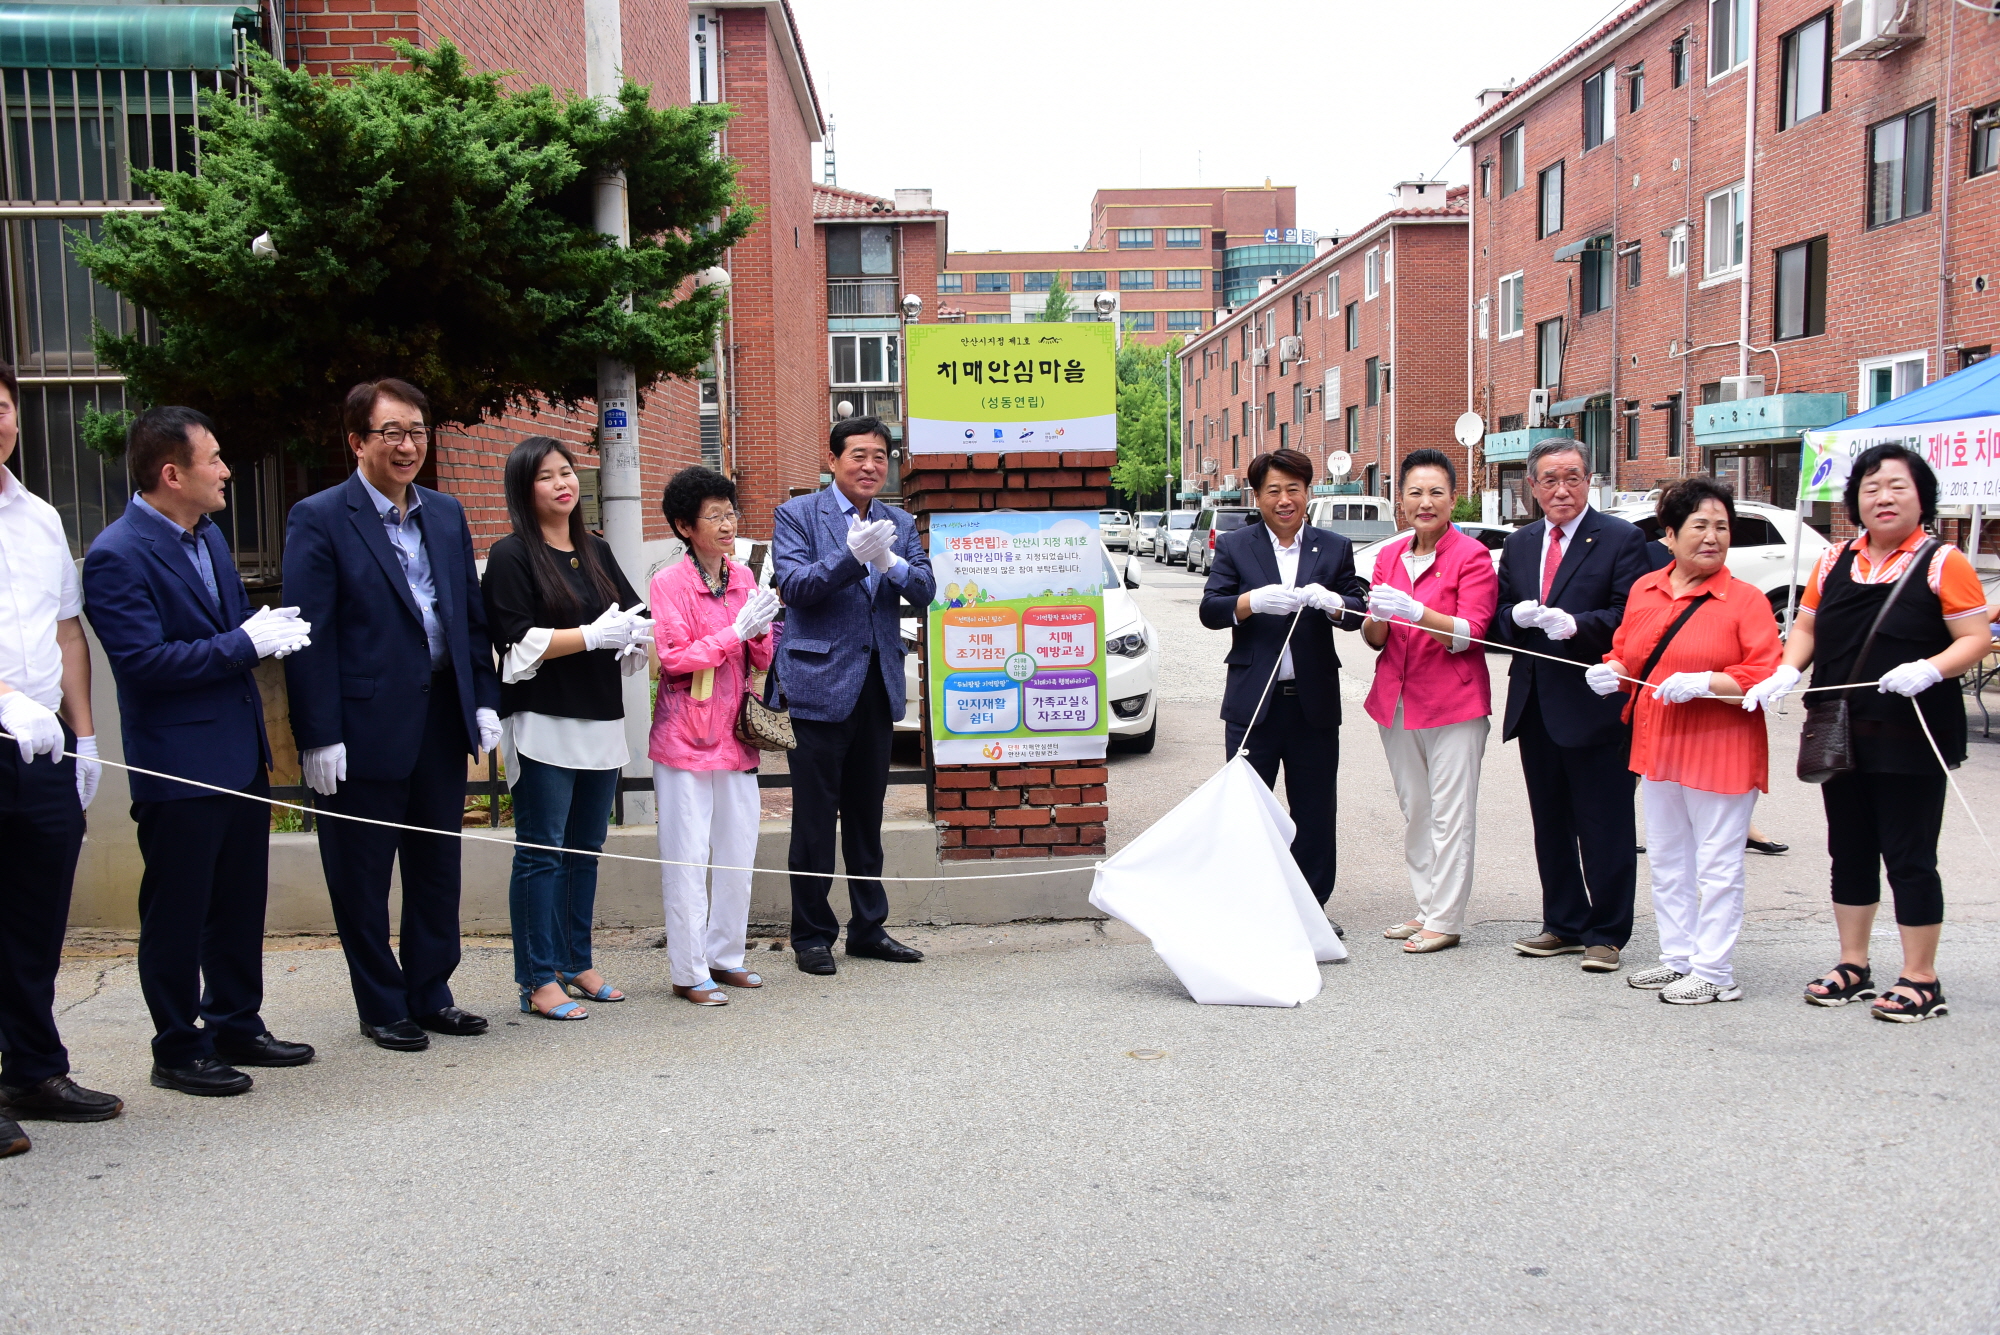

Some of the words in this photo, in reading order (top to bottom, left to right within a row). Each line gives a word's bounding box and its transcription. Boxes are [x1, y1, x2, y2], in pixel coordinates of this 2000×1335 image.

[960, 337, 1004, 346] 안산시지정
[1009, 337, 1030, 345] 제1호
[937, 359, 1086, 385] 치매안심마을
[981, 396, 1045, 409] (성동연립)
[1927, 431, 1968, 470] 제1호
[1950, 483, 1969, 497] 2018.
[1973, 482, 1978, 496] 7.
[945, 537, 1008, 549] [성동연립]은
[1012, 537, 1040, 548] 안산시
[1043, 537, 1060, 547] 지정
[1064, 536, 1088, 546] 제1호
[954, 552, 1022, 562] 치매안심마을로
[1026, 552, 1081, 561] 지정되었습니다.
[954, 566, 997, 575] 주민여러분의
[1001, 566, 1015, 574] 많은
[1019, 566, 1033, 574] 참여
[1037, 565, 1081, 573] 부탁드립니다.
[969, 634, 992, 645] 치매
[1049, 632, 1072, 643] 치매
[956, 648, 1005, 659] 조기검진
[1037, 646, 1085, 658] 예방교실
[957, 698, 1006, 710] 인지재활
[970, 712, 994, 724] 쉼터
[1038, 710, 1085, 721] 자조모임
